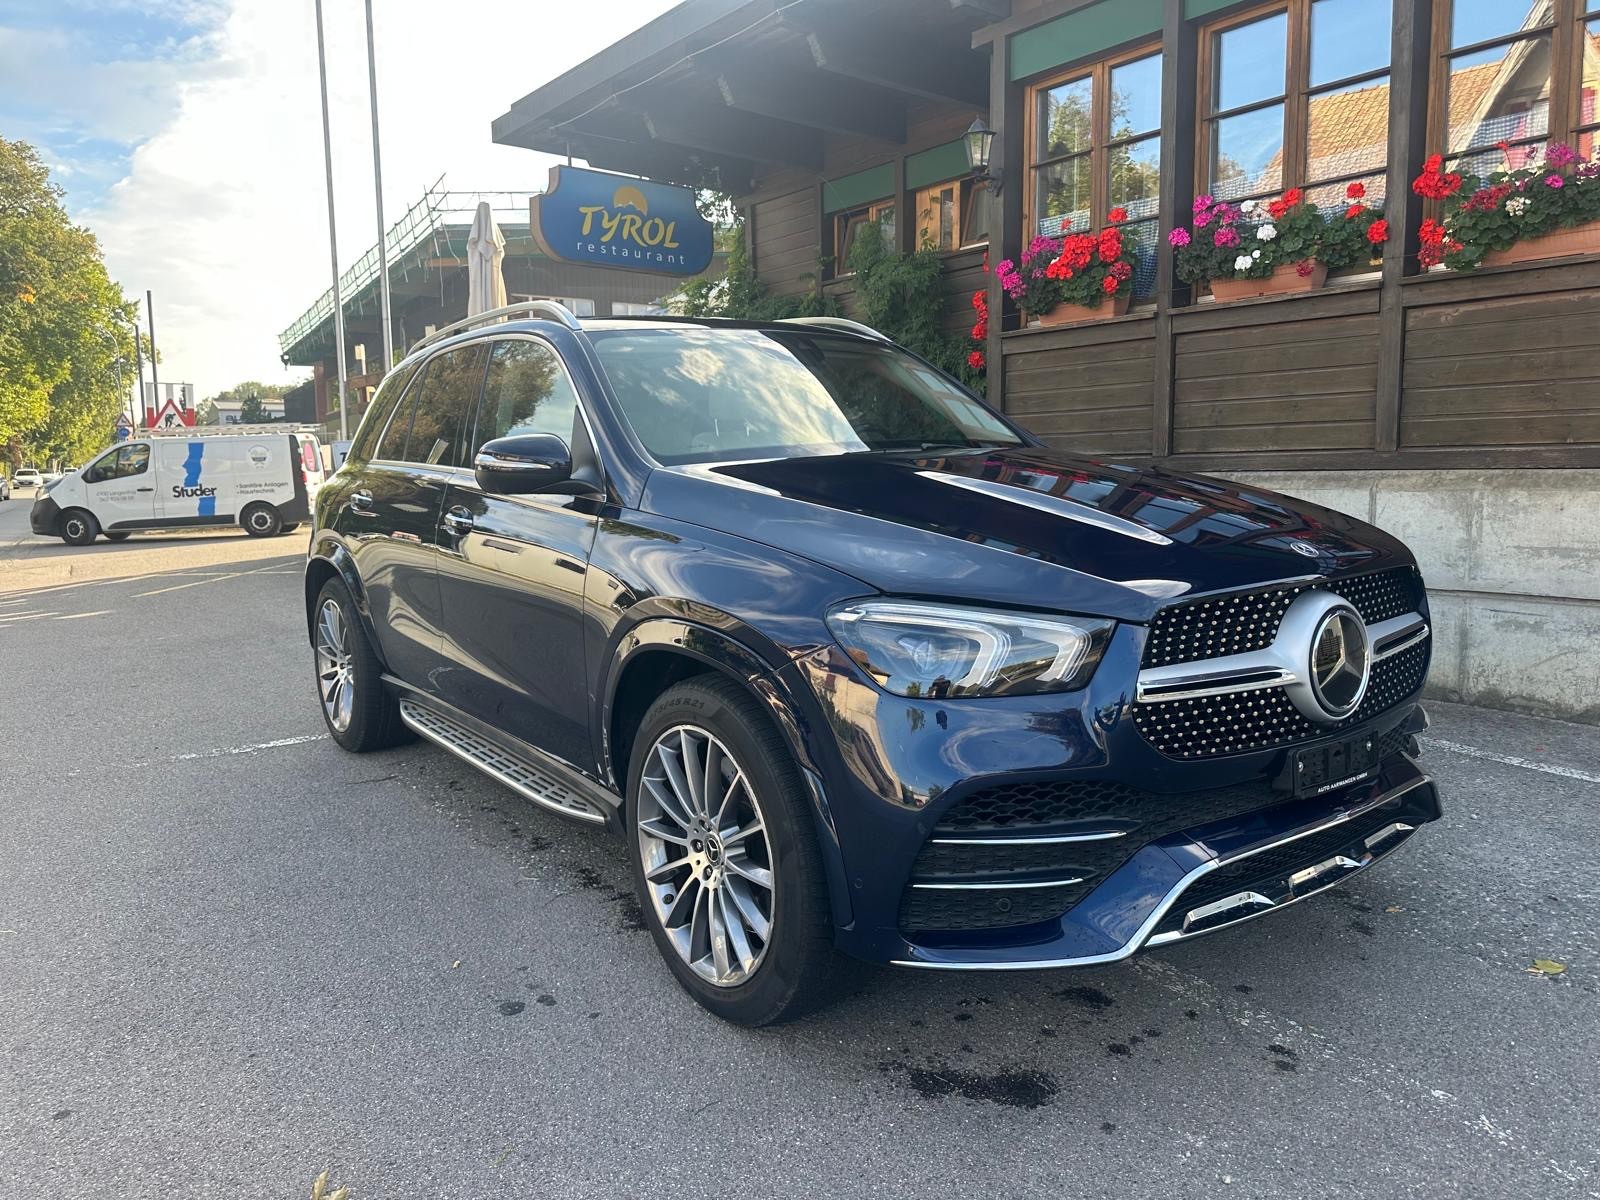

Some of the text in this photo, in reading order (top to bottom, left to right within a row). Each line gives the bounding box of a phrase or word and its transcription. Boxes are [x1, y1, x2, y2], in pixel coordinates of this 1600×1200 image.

[578, 206, 680, 249] TYROL
[576, 242, 685, 265] restaurant
[172, 484, 217, 498] Studer
[1317, 785, 1330, 793] AUTO
